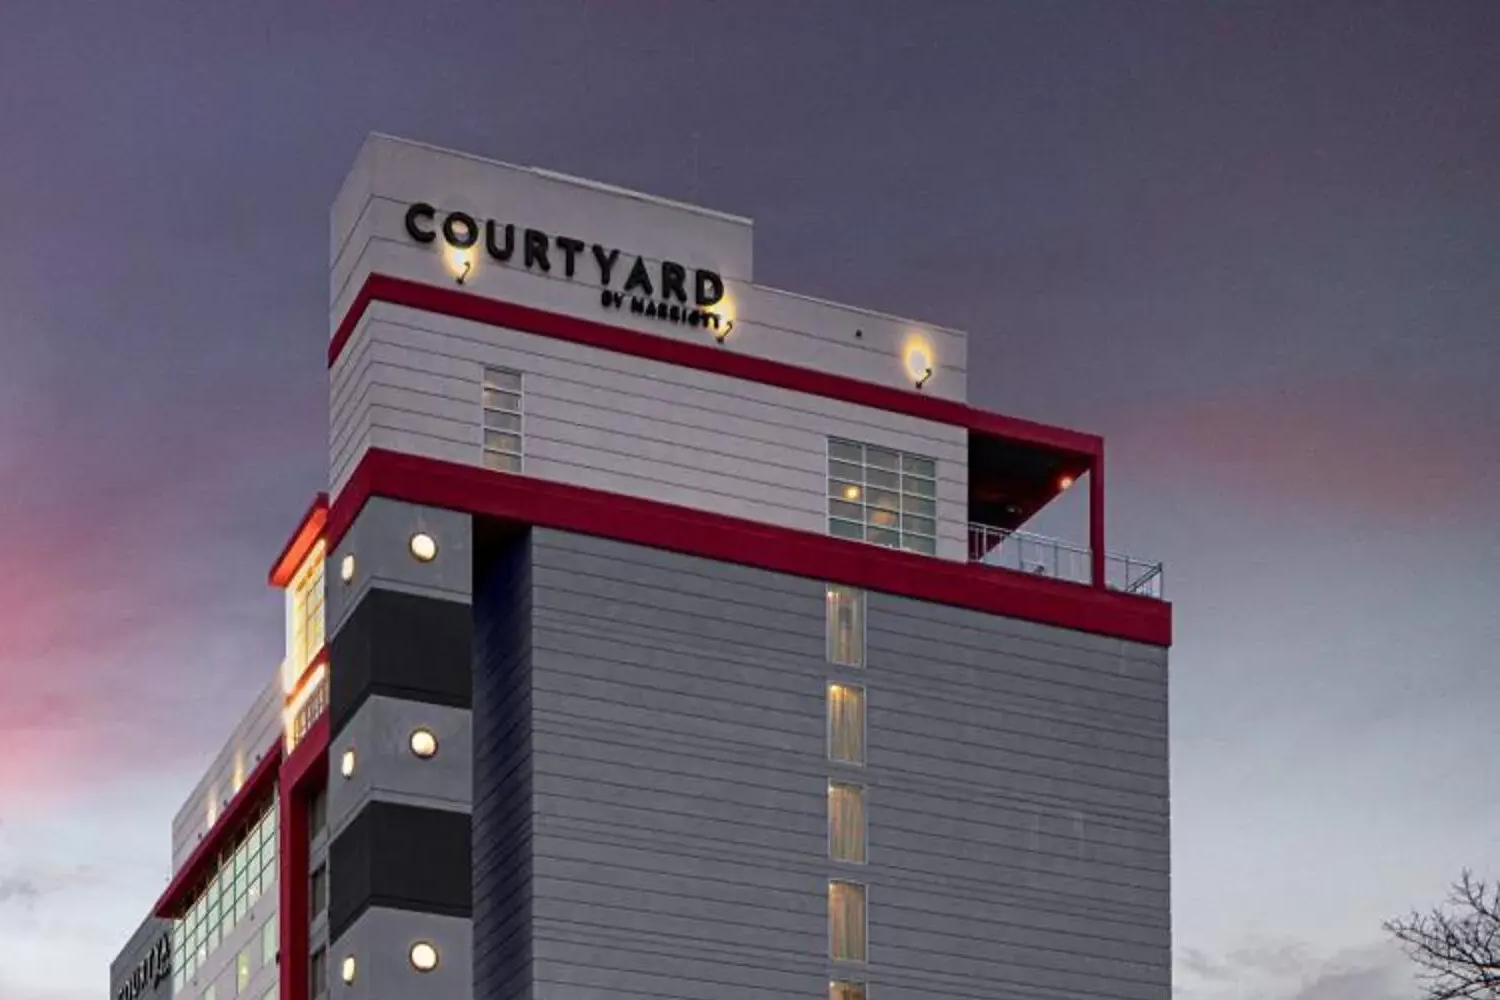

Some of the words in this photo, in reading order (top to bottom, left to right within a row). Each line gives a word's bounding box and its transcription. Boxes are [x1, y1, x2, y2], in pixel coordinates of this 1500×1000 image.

[404, 202, 725, 307] COURTYARD
[601, 289, 624, 309] BY
[631, 295, 721, 329] MARRIOTT
